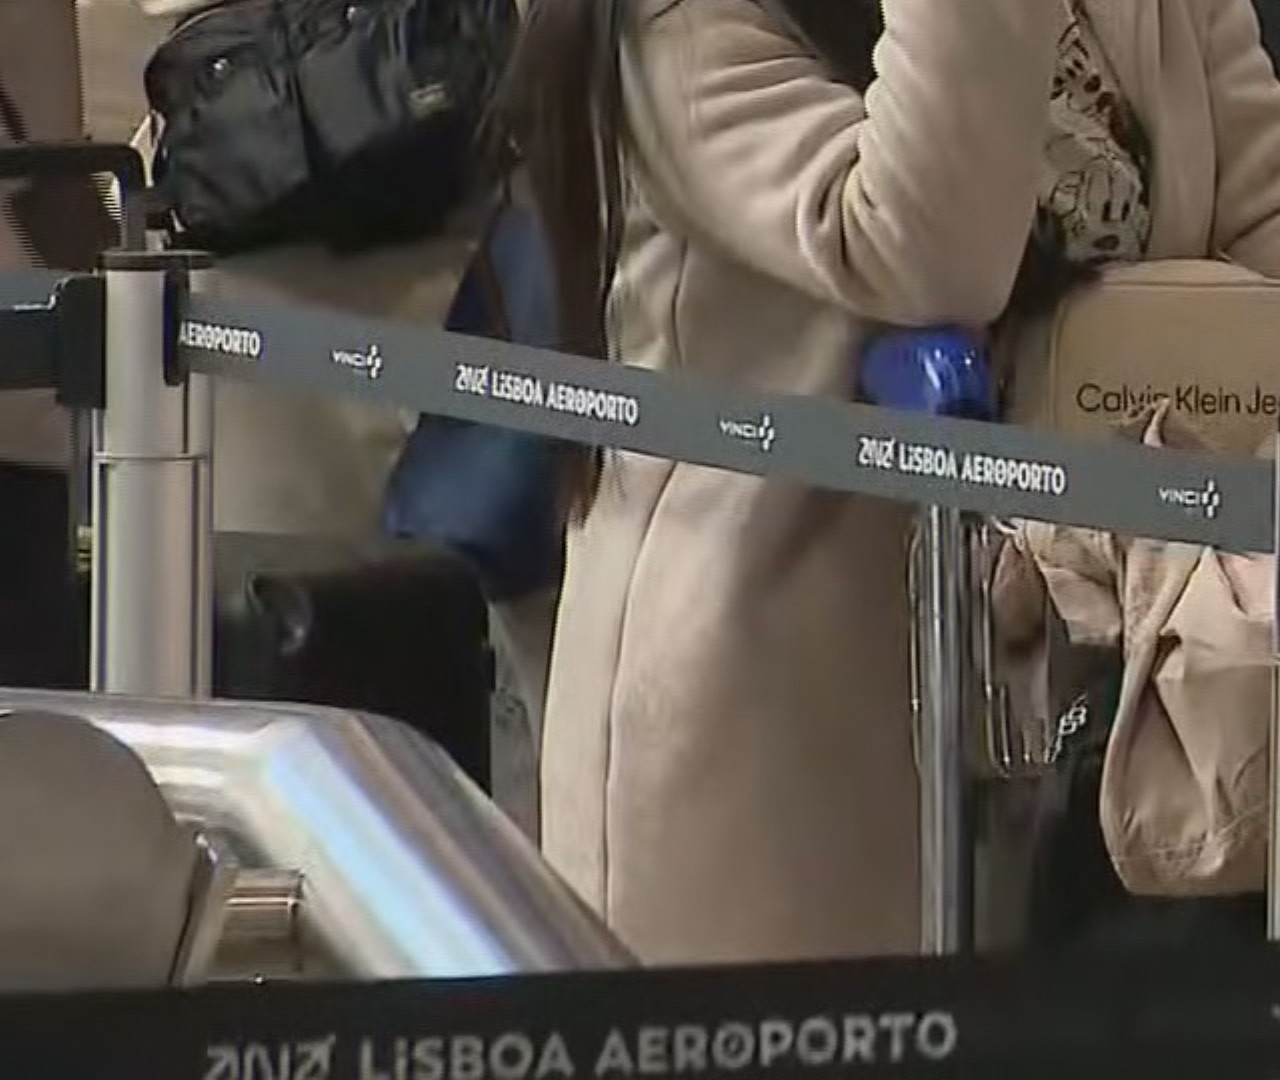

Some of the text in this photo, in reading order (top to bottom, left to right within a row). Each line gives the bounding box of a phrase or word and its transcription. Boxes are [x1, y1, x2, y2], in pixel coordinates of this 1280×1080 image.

[546, 382, 638, 425] AEROPORTO
[1175, 384, 1241, 413] Klein
[961, 454, 1065, 495] AEROPORTO
[594, 1010, 958, 1078] AEROPORTO
